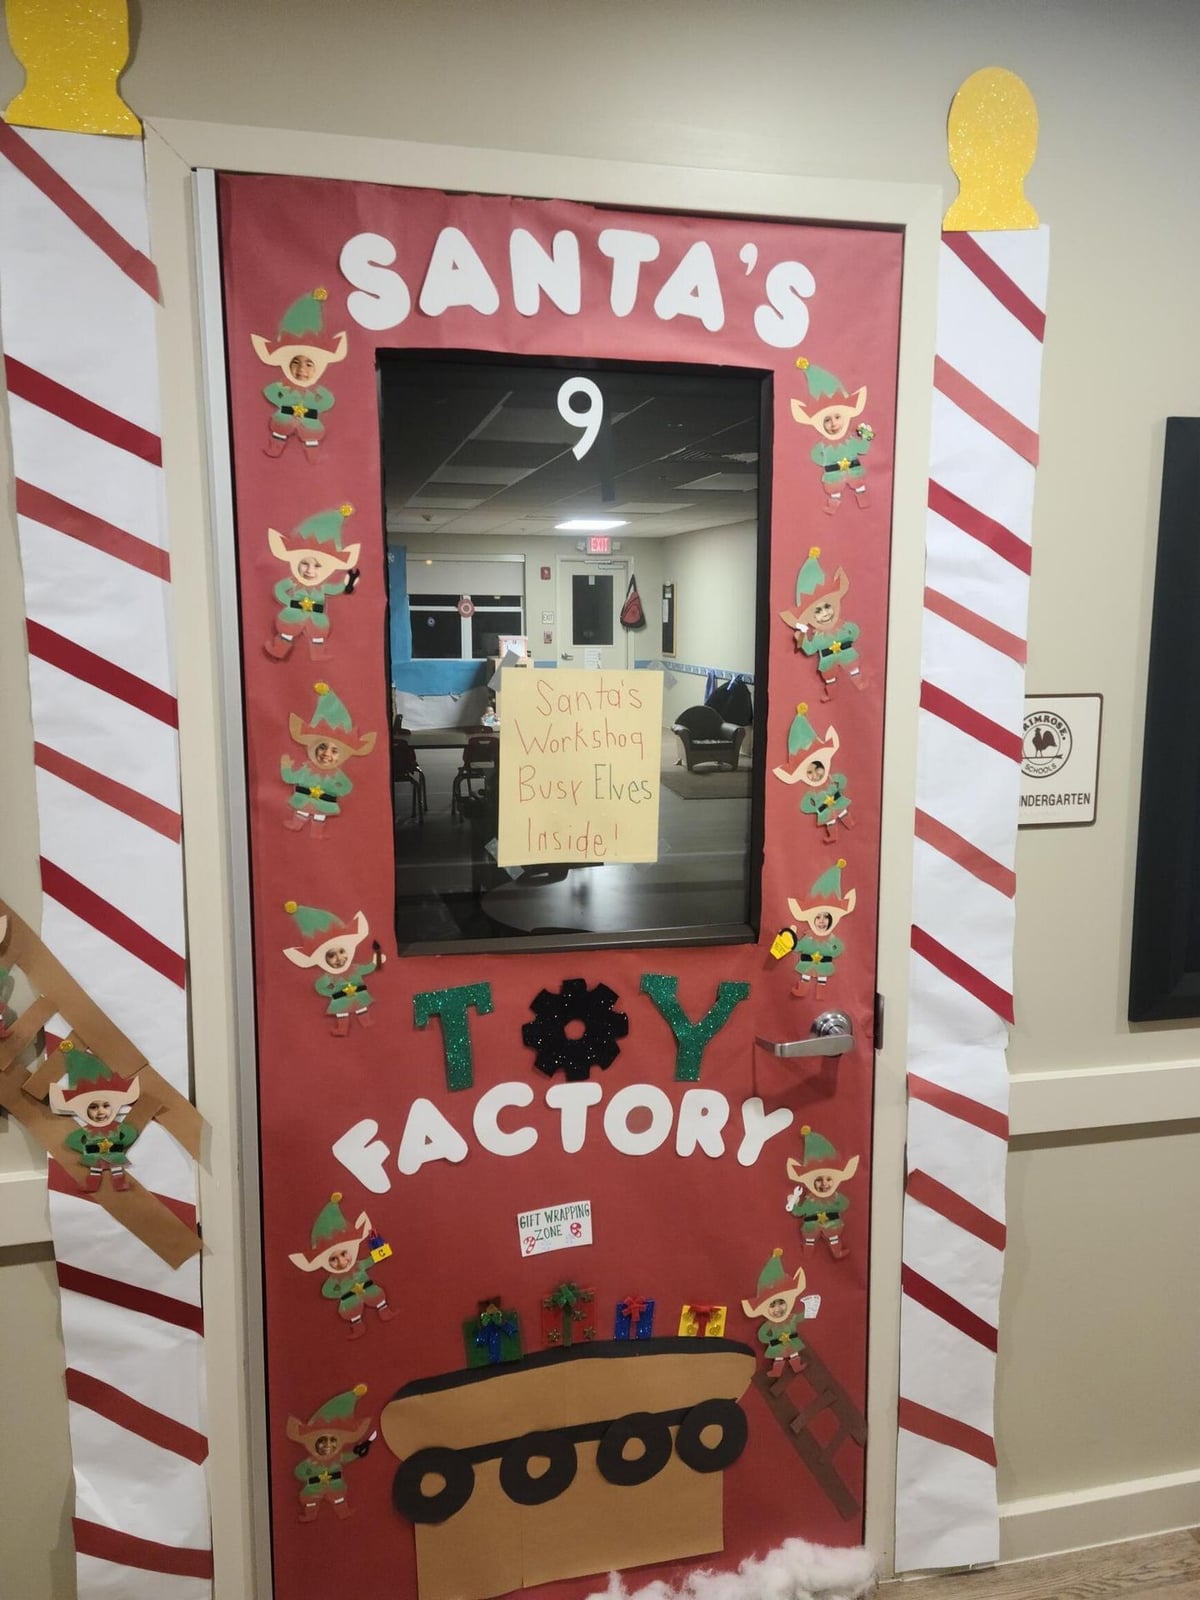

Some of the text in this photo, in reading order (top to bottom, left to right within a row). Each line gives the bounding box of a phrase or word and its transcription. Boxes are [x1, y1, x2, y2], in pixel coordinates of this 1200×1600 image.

[339, 226, 816, 348] SANTA'S
[557, 376, 604, 461] 9
[591, 537, 608, 552] EXIT
[536, 677, 643, 717] Santa's
[1022, 714, 1068, 737] RIMROSE
[519, 763, 652, 806] Busy Elves
[1025, 762, 1057, 775] SCHOOLS
[1020, 792, 1091, 807] NDERGARTEN
[528, 817, 619, 859] Inside!
[413, 974, 751, 1092] TOY
[332, 1082, 794, 1194] FACTORY
[519, 1203, 590, 1229] GIFT WRAPPING
[534, 1224, 563, 1241] ZONE
